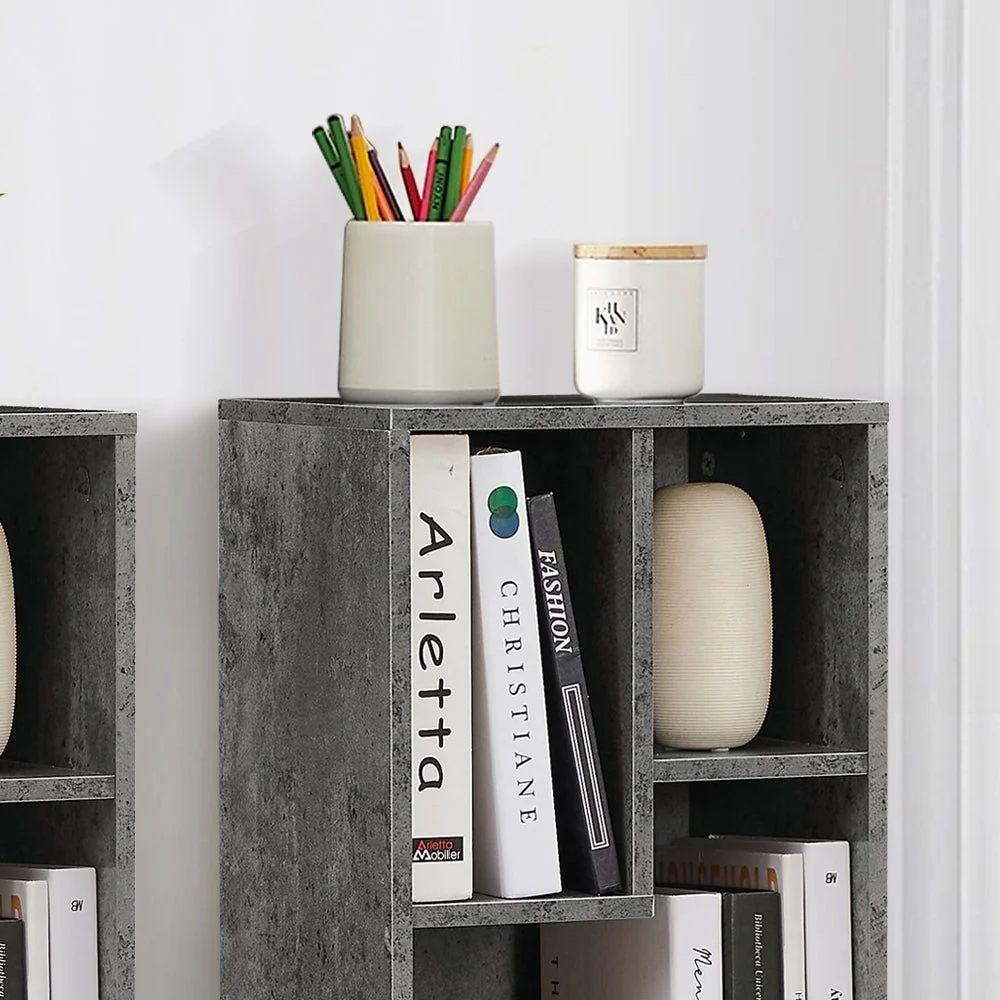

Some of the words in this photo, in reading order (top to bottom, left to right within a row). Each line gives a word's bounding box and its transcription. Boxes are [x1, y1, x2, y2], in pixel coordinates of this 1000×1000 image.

[418, 512, 457, 793] Arletta
[538, 550, 573, 654] FASHION
[500, 580, 538, 824] CHRISTIANE
[417, 840, 454, 851] Arletta
